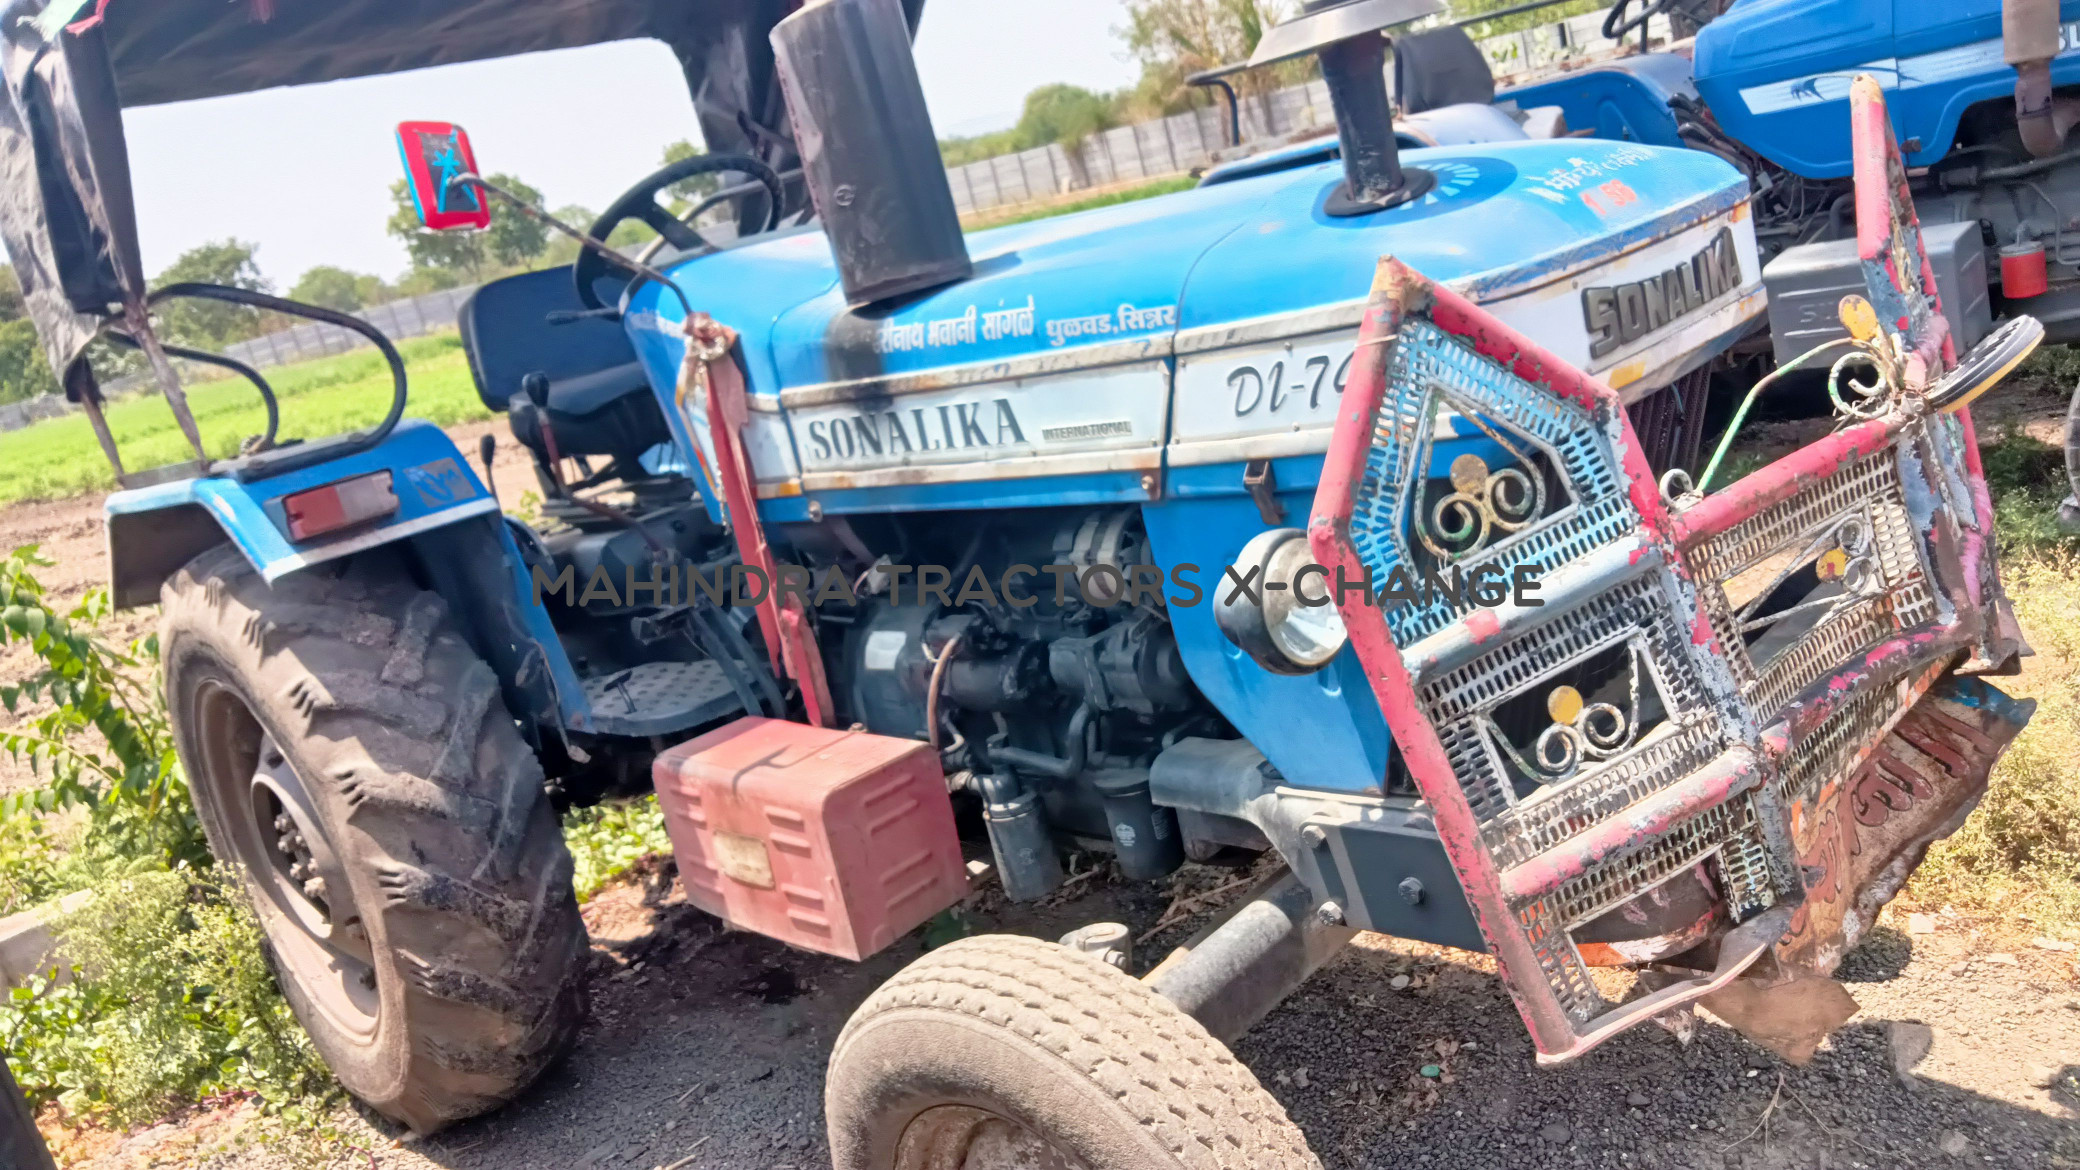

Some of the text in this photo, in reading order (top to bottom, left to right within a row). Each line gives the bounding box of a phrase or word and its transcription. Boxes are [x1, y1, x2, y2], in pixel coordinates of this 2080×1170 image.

[1581, 226, 1742, 359] SONALIKA
[809, 398, 1132, 461] SONALIKA INTERNATIONAL
